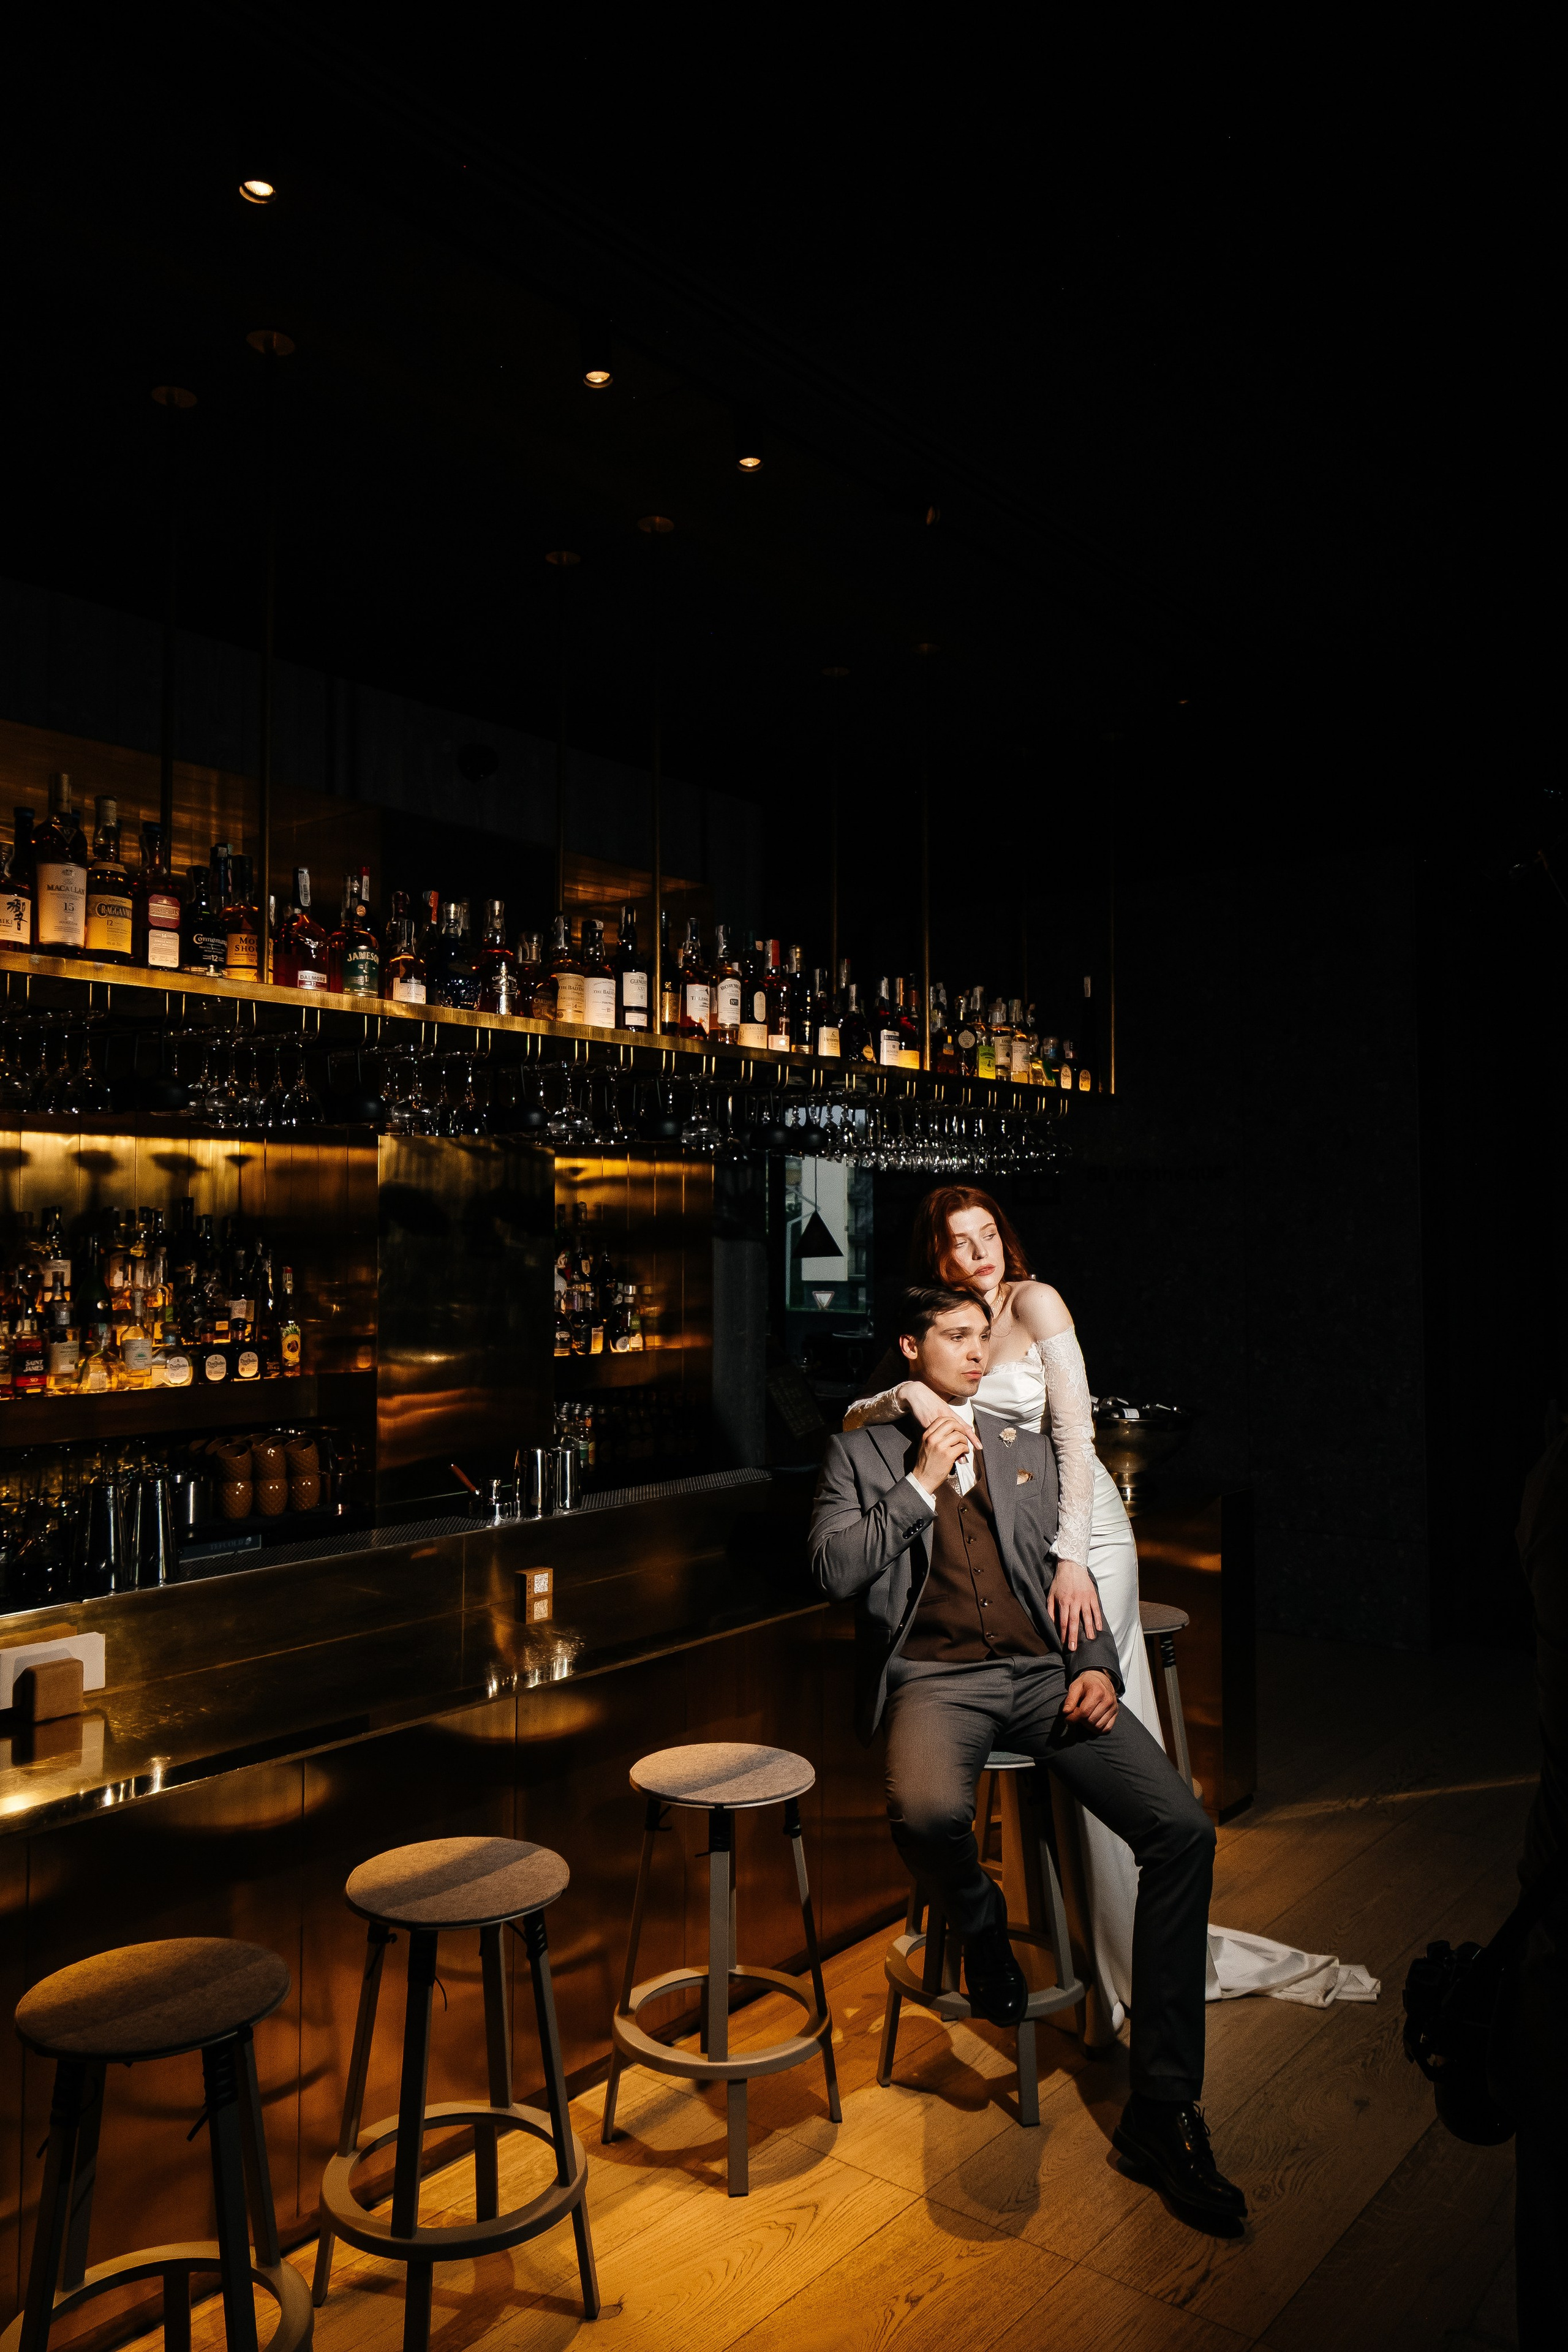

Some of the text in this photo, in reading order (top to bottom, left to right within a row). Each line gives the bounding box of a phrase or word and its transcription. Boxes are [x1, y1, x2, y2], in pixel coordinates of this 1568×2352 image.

[47, 884, 85, 895] MACALLAN
[64, 902, 74, 911] 15
[239, 937, 257, 945] MO
